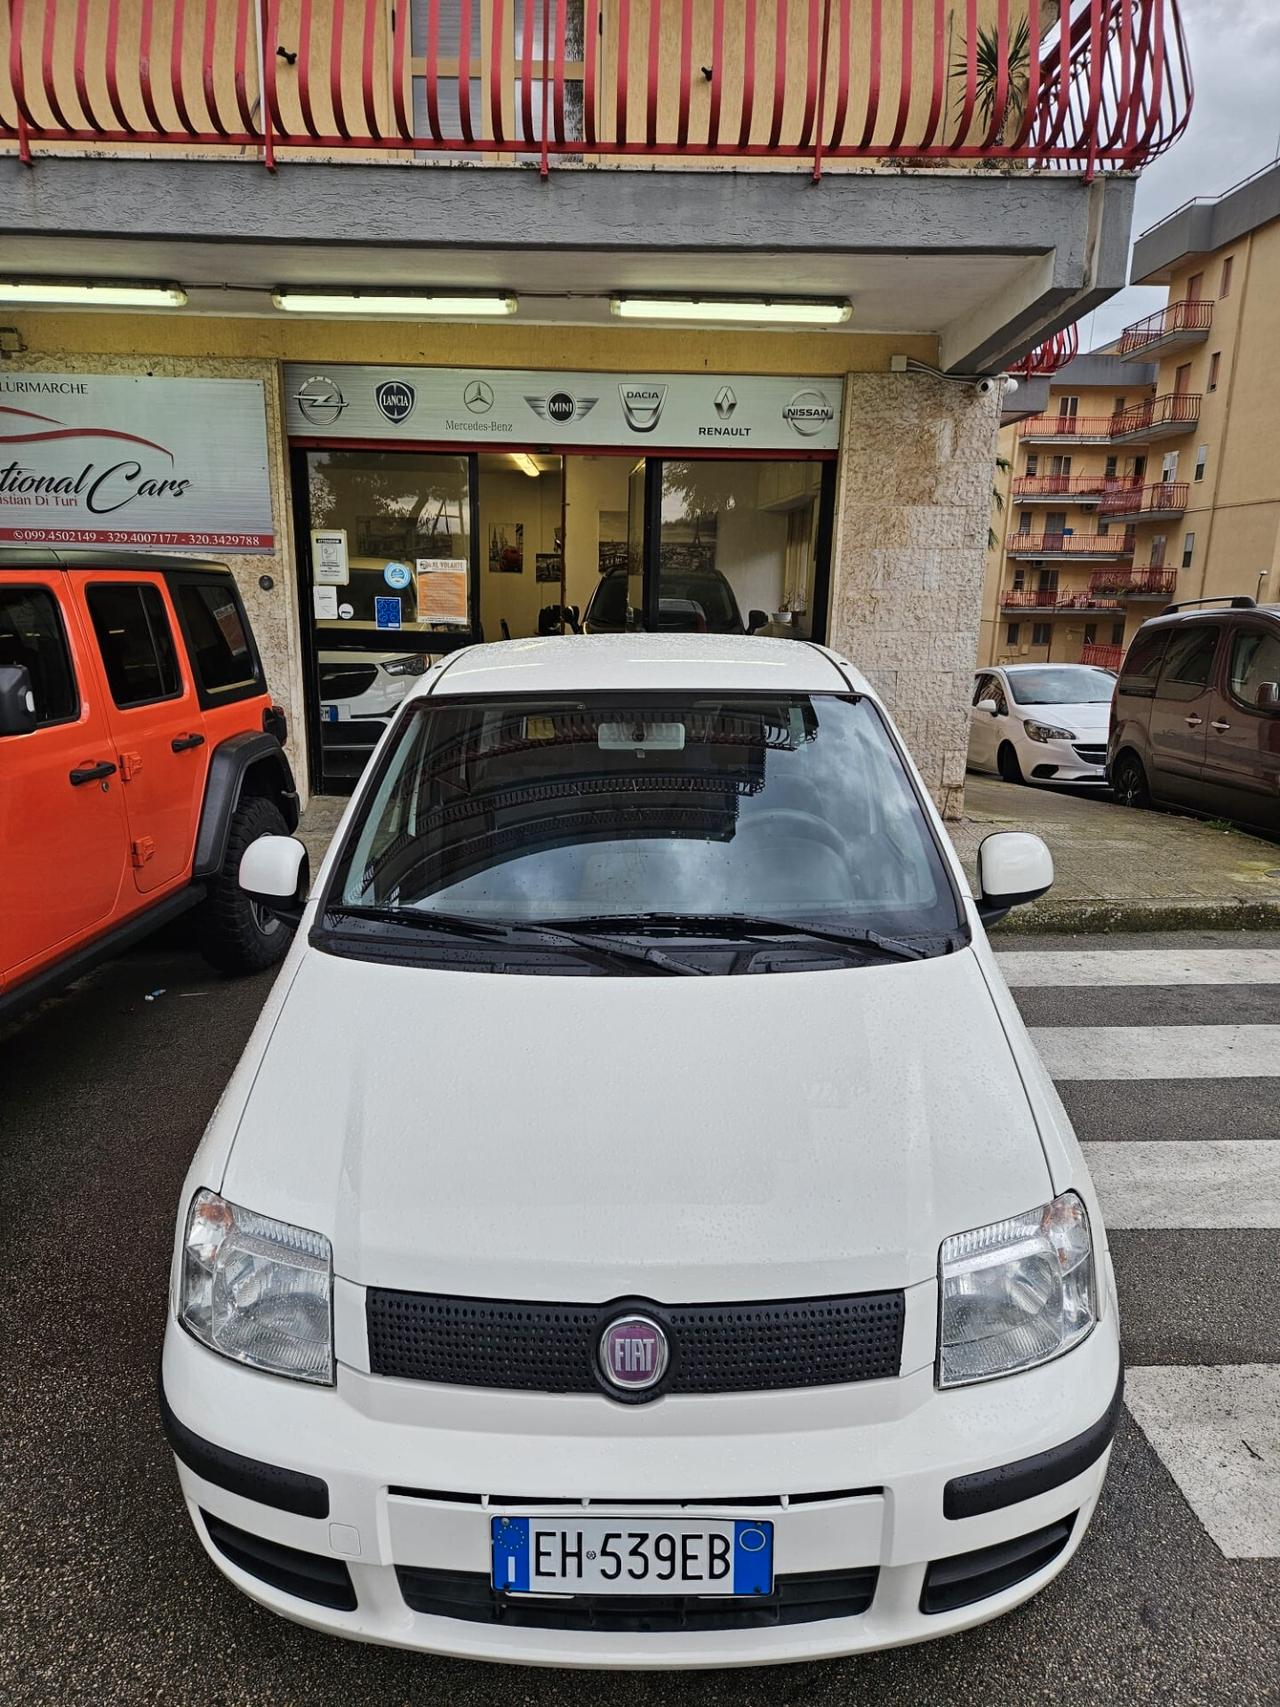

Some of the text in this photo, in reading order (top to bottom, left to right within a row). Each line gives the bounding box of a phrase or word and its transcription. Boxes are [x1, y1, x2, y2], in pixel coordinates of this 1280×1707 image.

[383, 395, 408, 406] LANCIA
[626, 391, 659, 399] DACIA
[549, 402, 573, 413] MINI
[787, 408, 829, 417] NISSAN
[445, 420, 513, 432] Mercedes-Benz
[698, 427, 751, 436] RENAULT
[86, 461, 193, 514] Cars
[36, 495, 49, 506] Di
[52, 495, 78, 506] Turi
[24, 530, 97, 541] 099.4502149
[107, 532, 178, 543] 329.4007177
[188, 534, 260, 546] 320.3429788
[614, 1338, 655, 1371] FIAT
